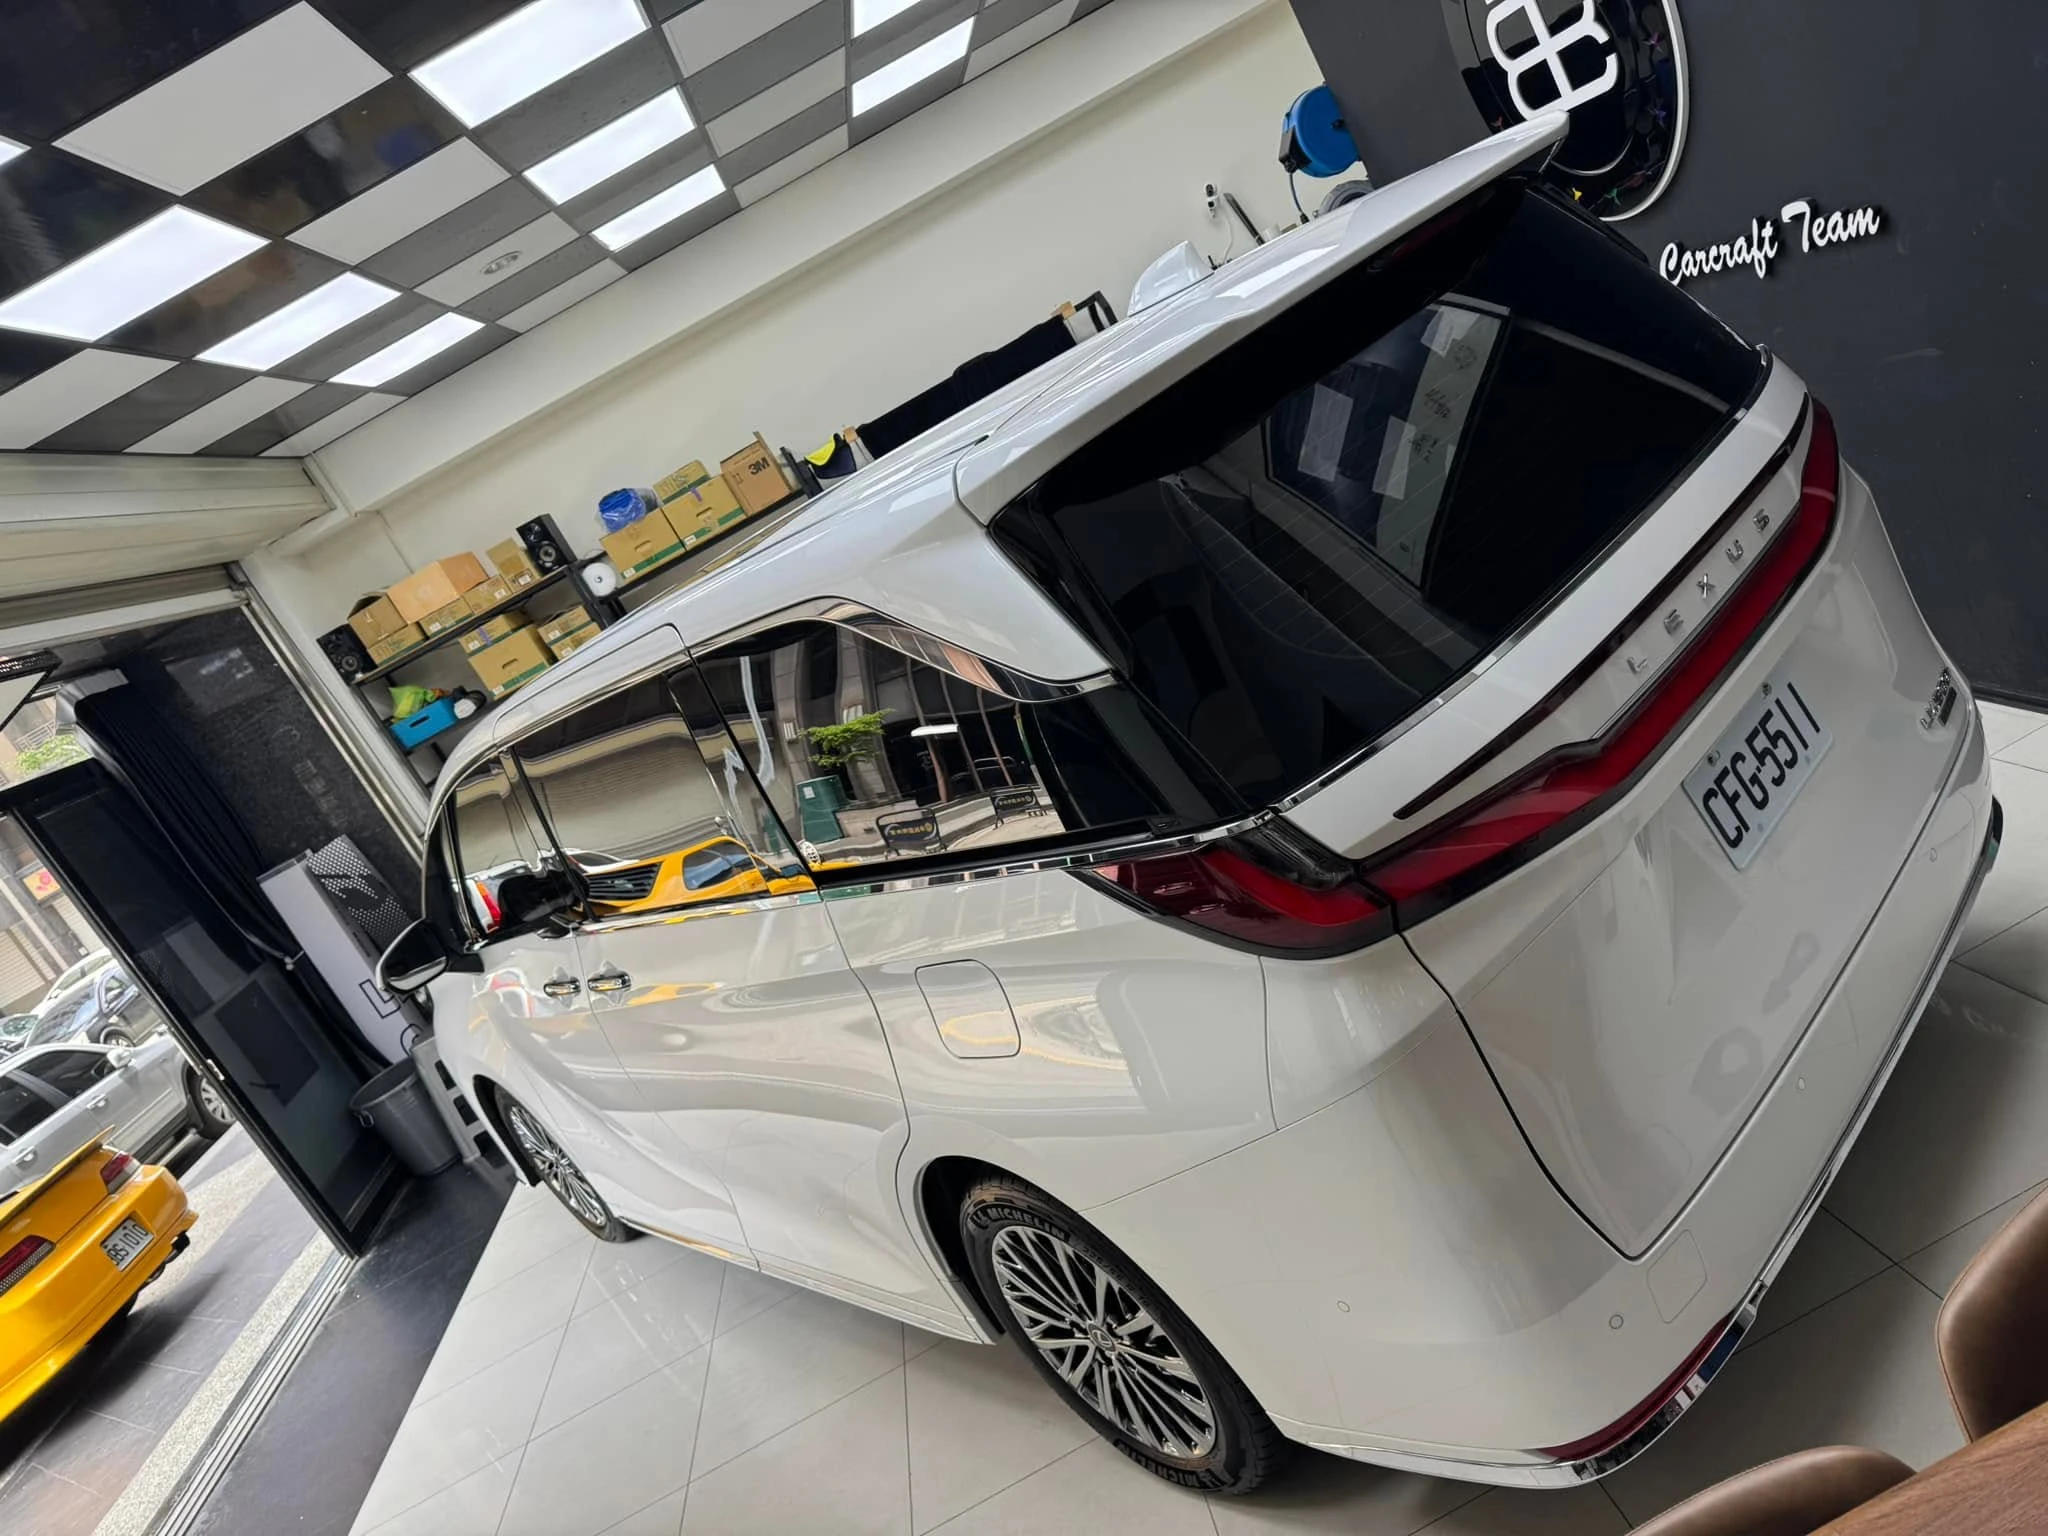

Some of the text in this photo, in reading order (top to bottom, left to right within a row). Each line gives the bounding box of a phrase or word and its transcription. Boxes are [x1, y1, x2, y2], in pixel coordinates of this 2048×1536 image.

[1659, 200, 1880, 286] Carcraft Team
[747, 456, 771, 476] 3M
[1626, 508, 1770, 675] LEXUS
[986, 1206, 1066, 1239] MICHELIN
